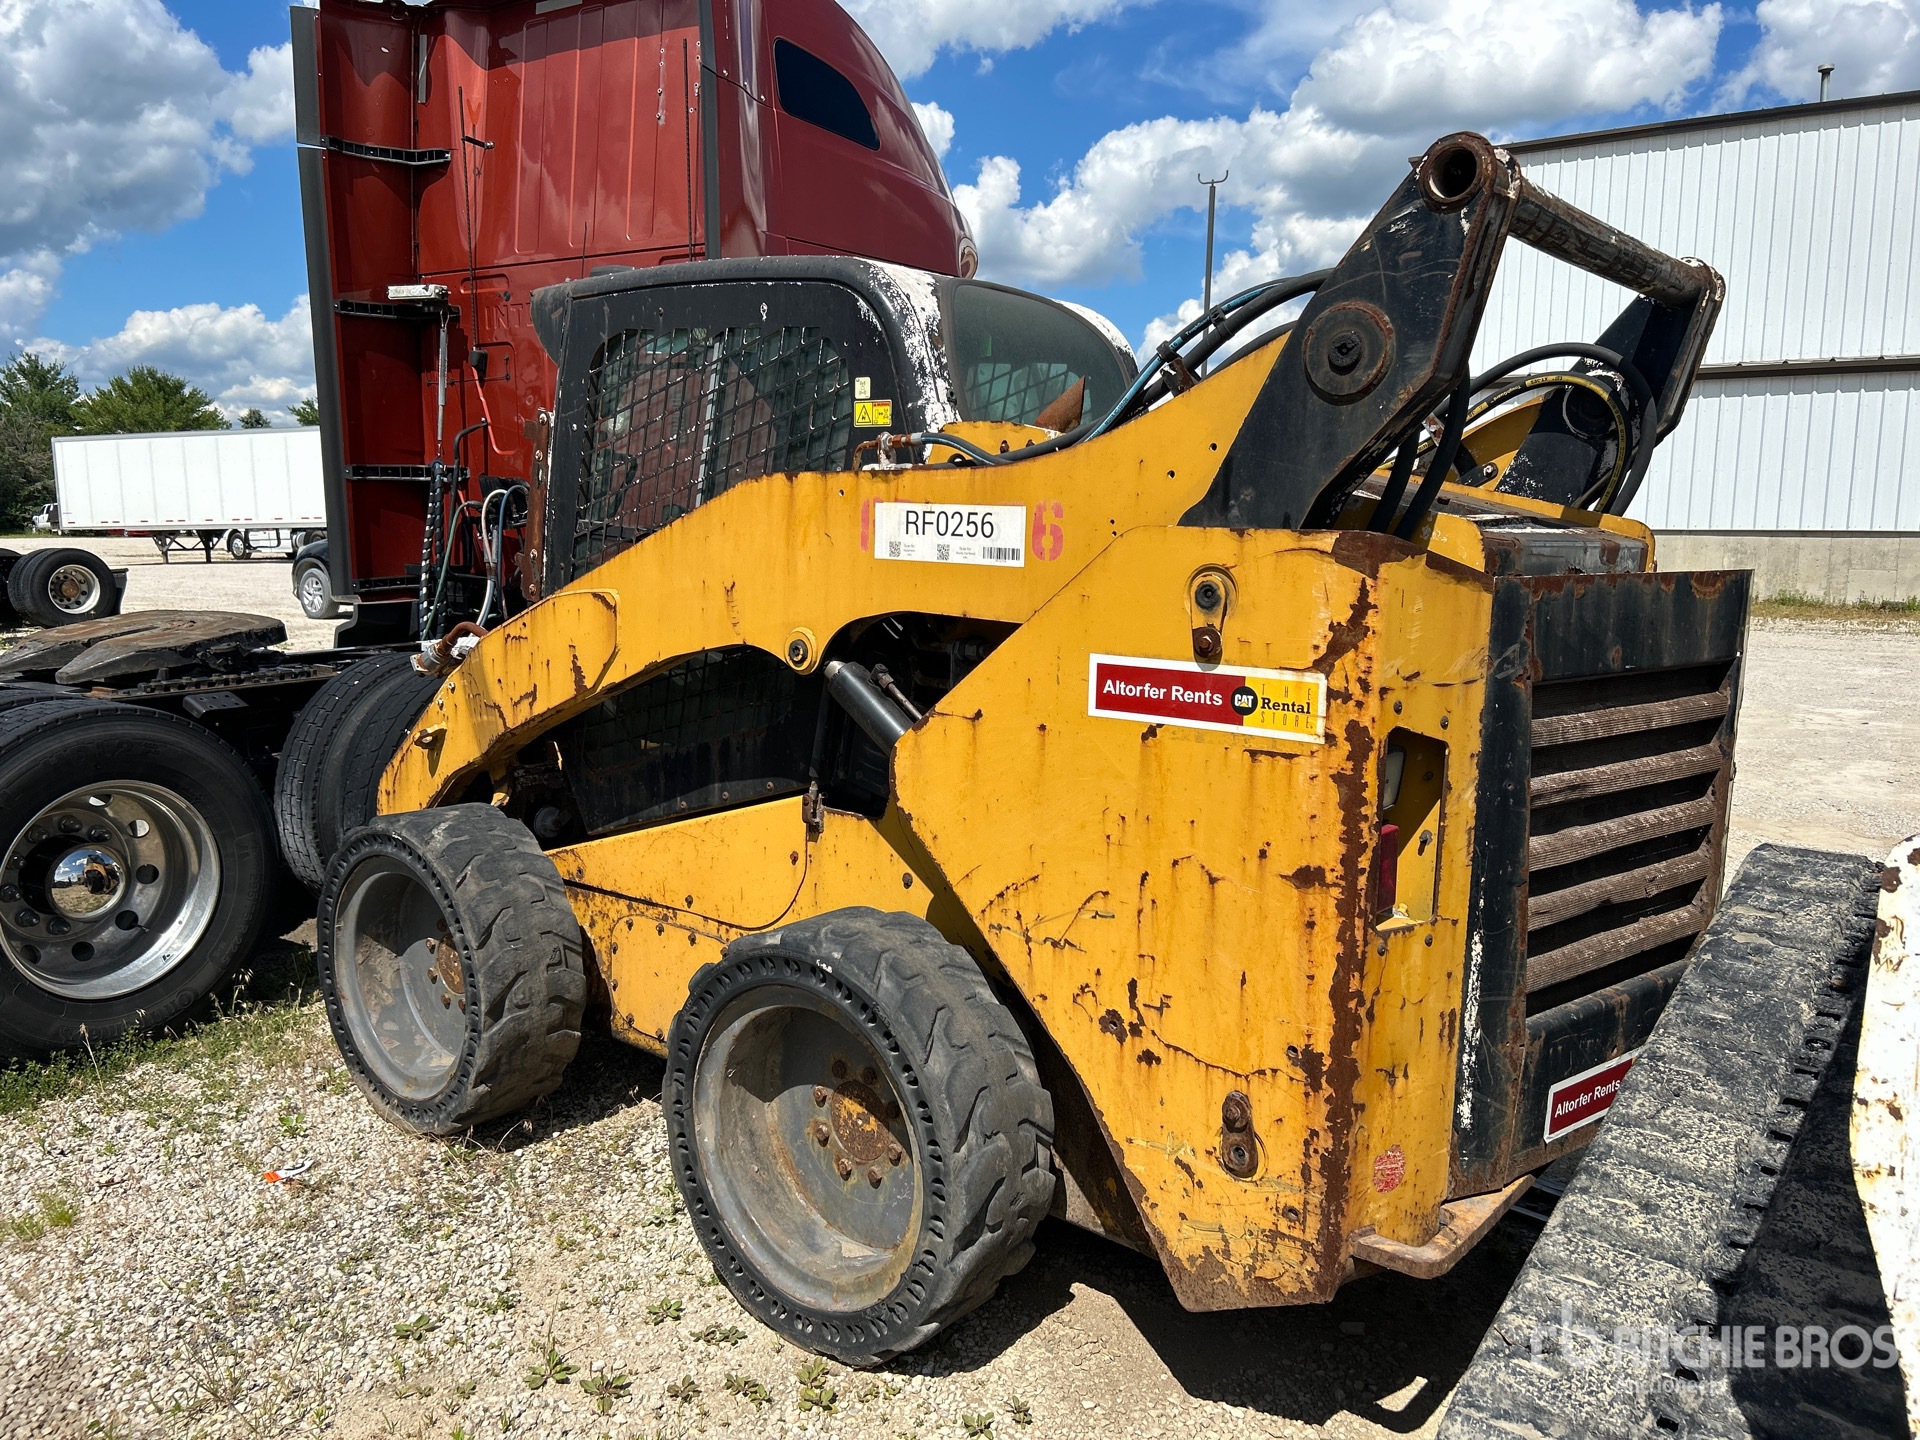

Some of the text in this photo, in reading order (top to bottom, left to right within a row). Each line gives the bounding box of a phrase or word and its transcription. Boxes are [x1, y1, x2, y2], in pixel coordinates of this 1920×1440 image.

[905, 510, 995, 538] RF0256
[1103, 679, 1223, 706] Altorfer Rents
[1234, 693, 1254, 708] CAT
[1261, 696, 1311, 715] Rental
[1555, 1080, 1621, 1118] Altorfer Rents
